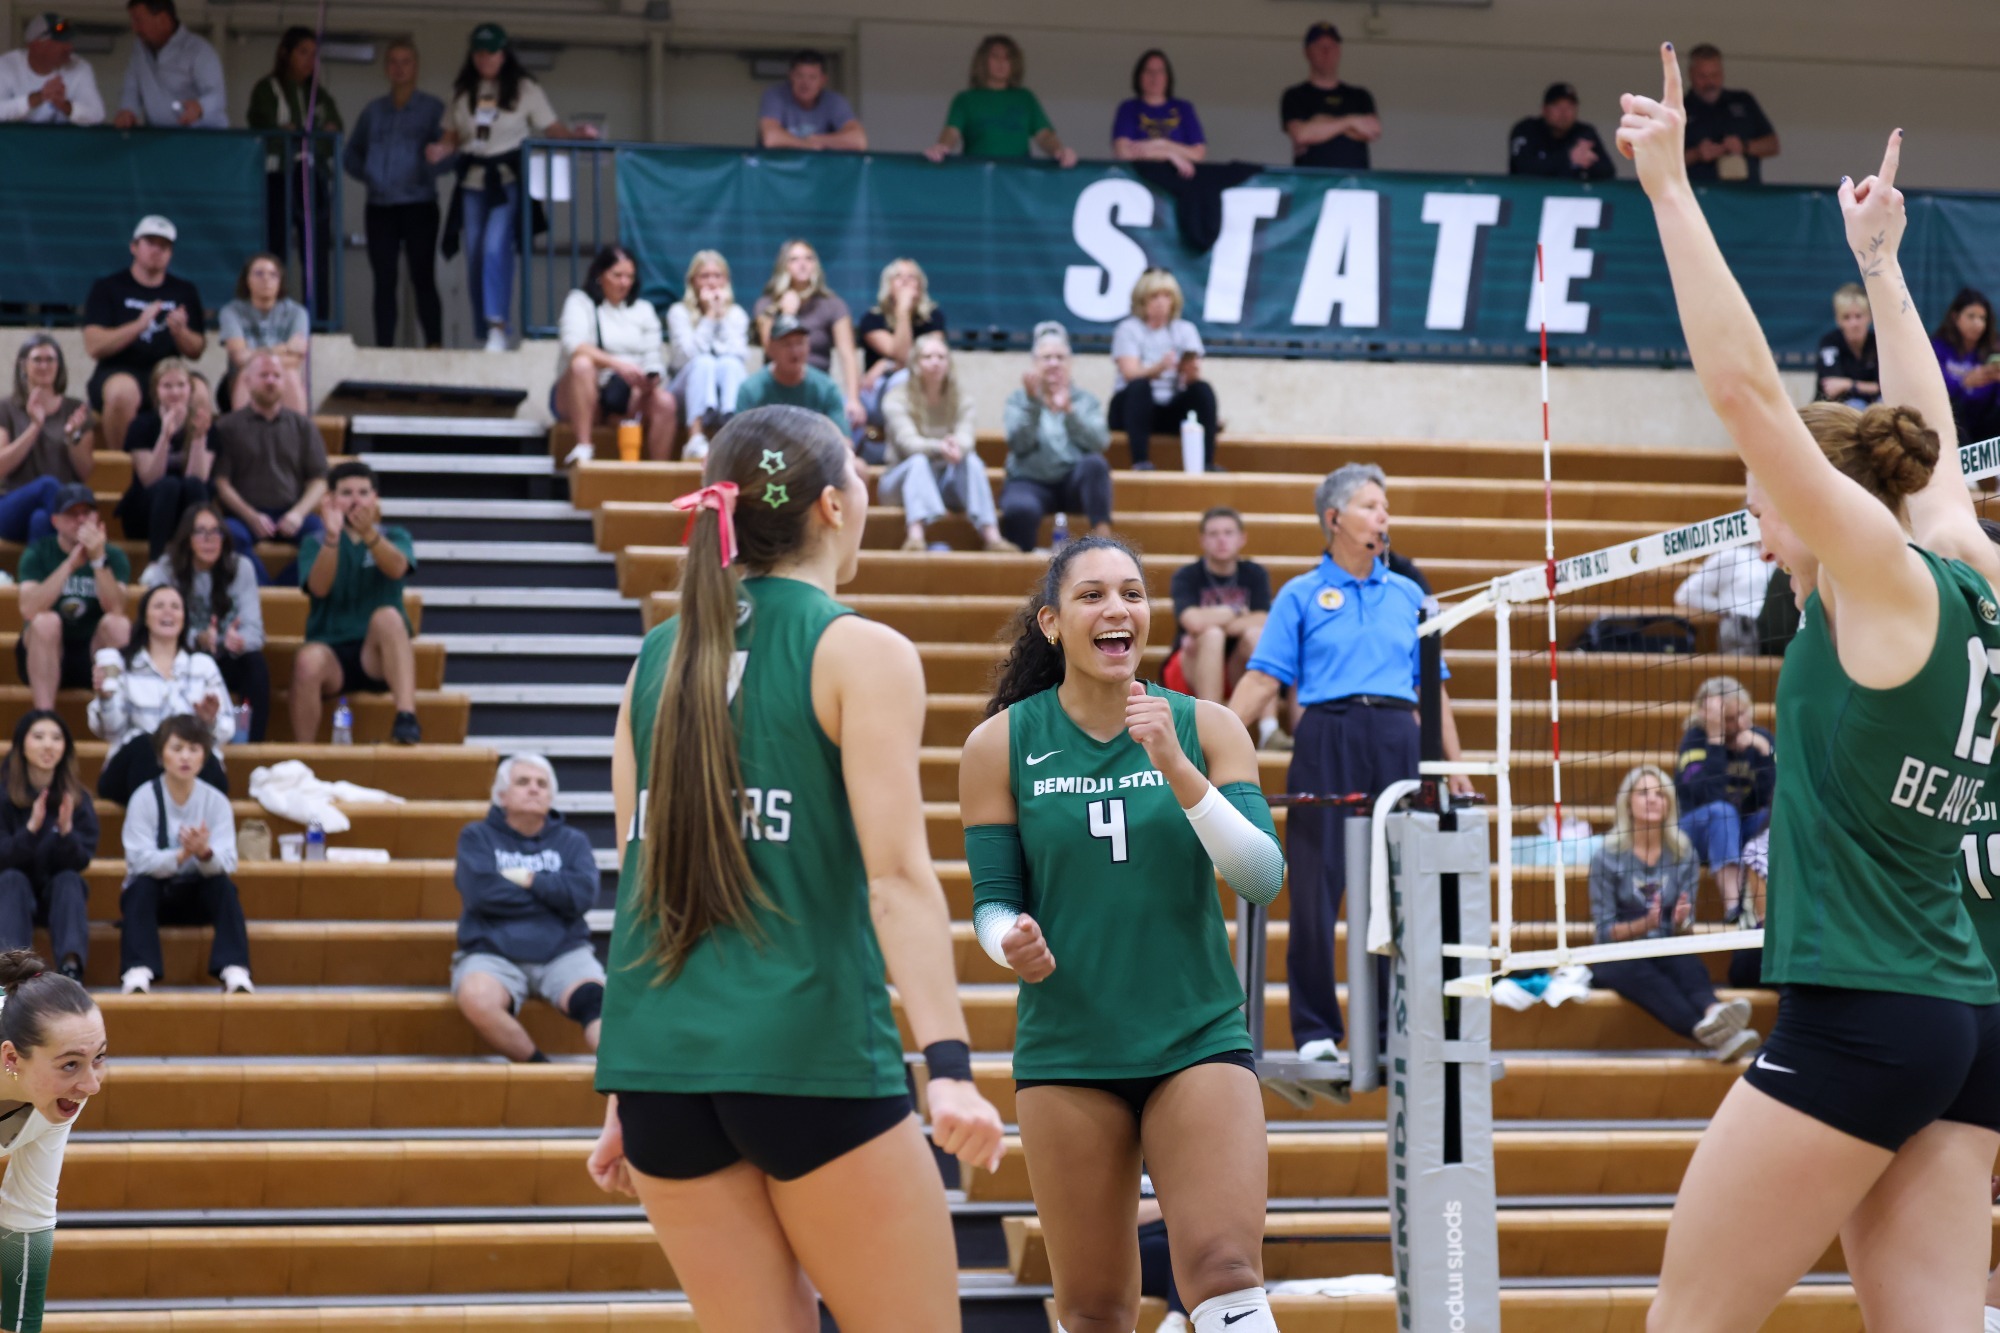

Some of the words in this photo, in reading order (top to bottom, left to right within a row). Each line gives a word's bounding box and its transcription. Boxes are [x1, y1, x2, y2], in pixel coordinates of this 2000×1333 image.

[1063, 178, 1603, 334] STATE
[1960, 438, 2000, 475] BEMI
[1663, 523, 1711, 556] BEMIDJI
[1713, 512, 1749, 543] STATE
[1572, 556, 1593, 580] FOR
[1033, 776, 1114, 797] BEMIDJI
[1119, 770, 1170, 789] STAT
[1087, 797, 1129, 864] 4
[1442, 1200, 1466, 1267] sports
[1445, 1272, 1467, 1333] impo
